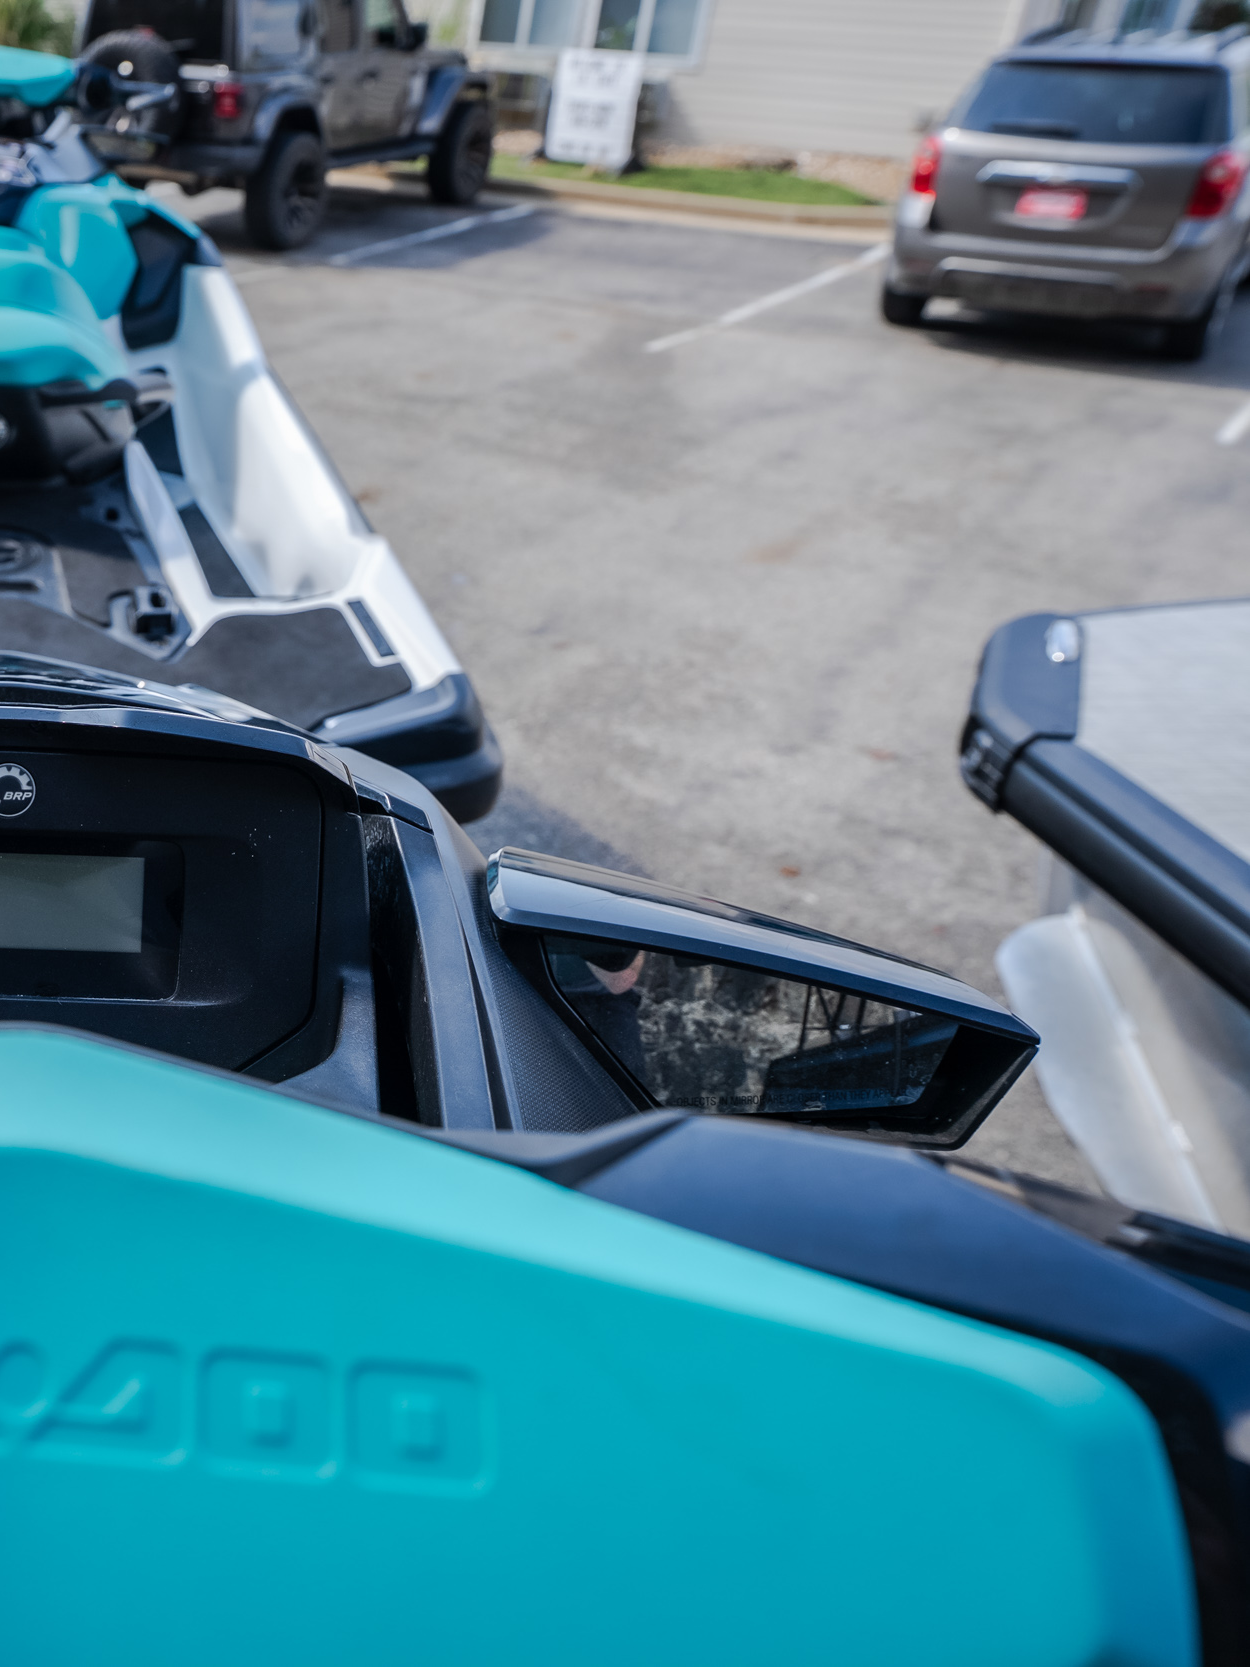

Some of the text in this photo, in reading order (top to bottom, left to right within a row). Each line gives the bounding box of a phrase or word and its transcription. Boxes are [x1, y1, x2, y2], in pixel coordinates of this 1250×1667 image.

[3, 791, 33, 801] BRP
[676, 1096, 717, 1107] OBJECTS
[719, 1096, 729, 1106] IN
[730, 1094, 765, 1106] MIRROR
[767, 1094, 786, 1105] ARE
[850, 1090, 871, 1101] THEY
